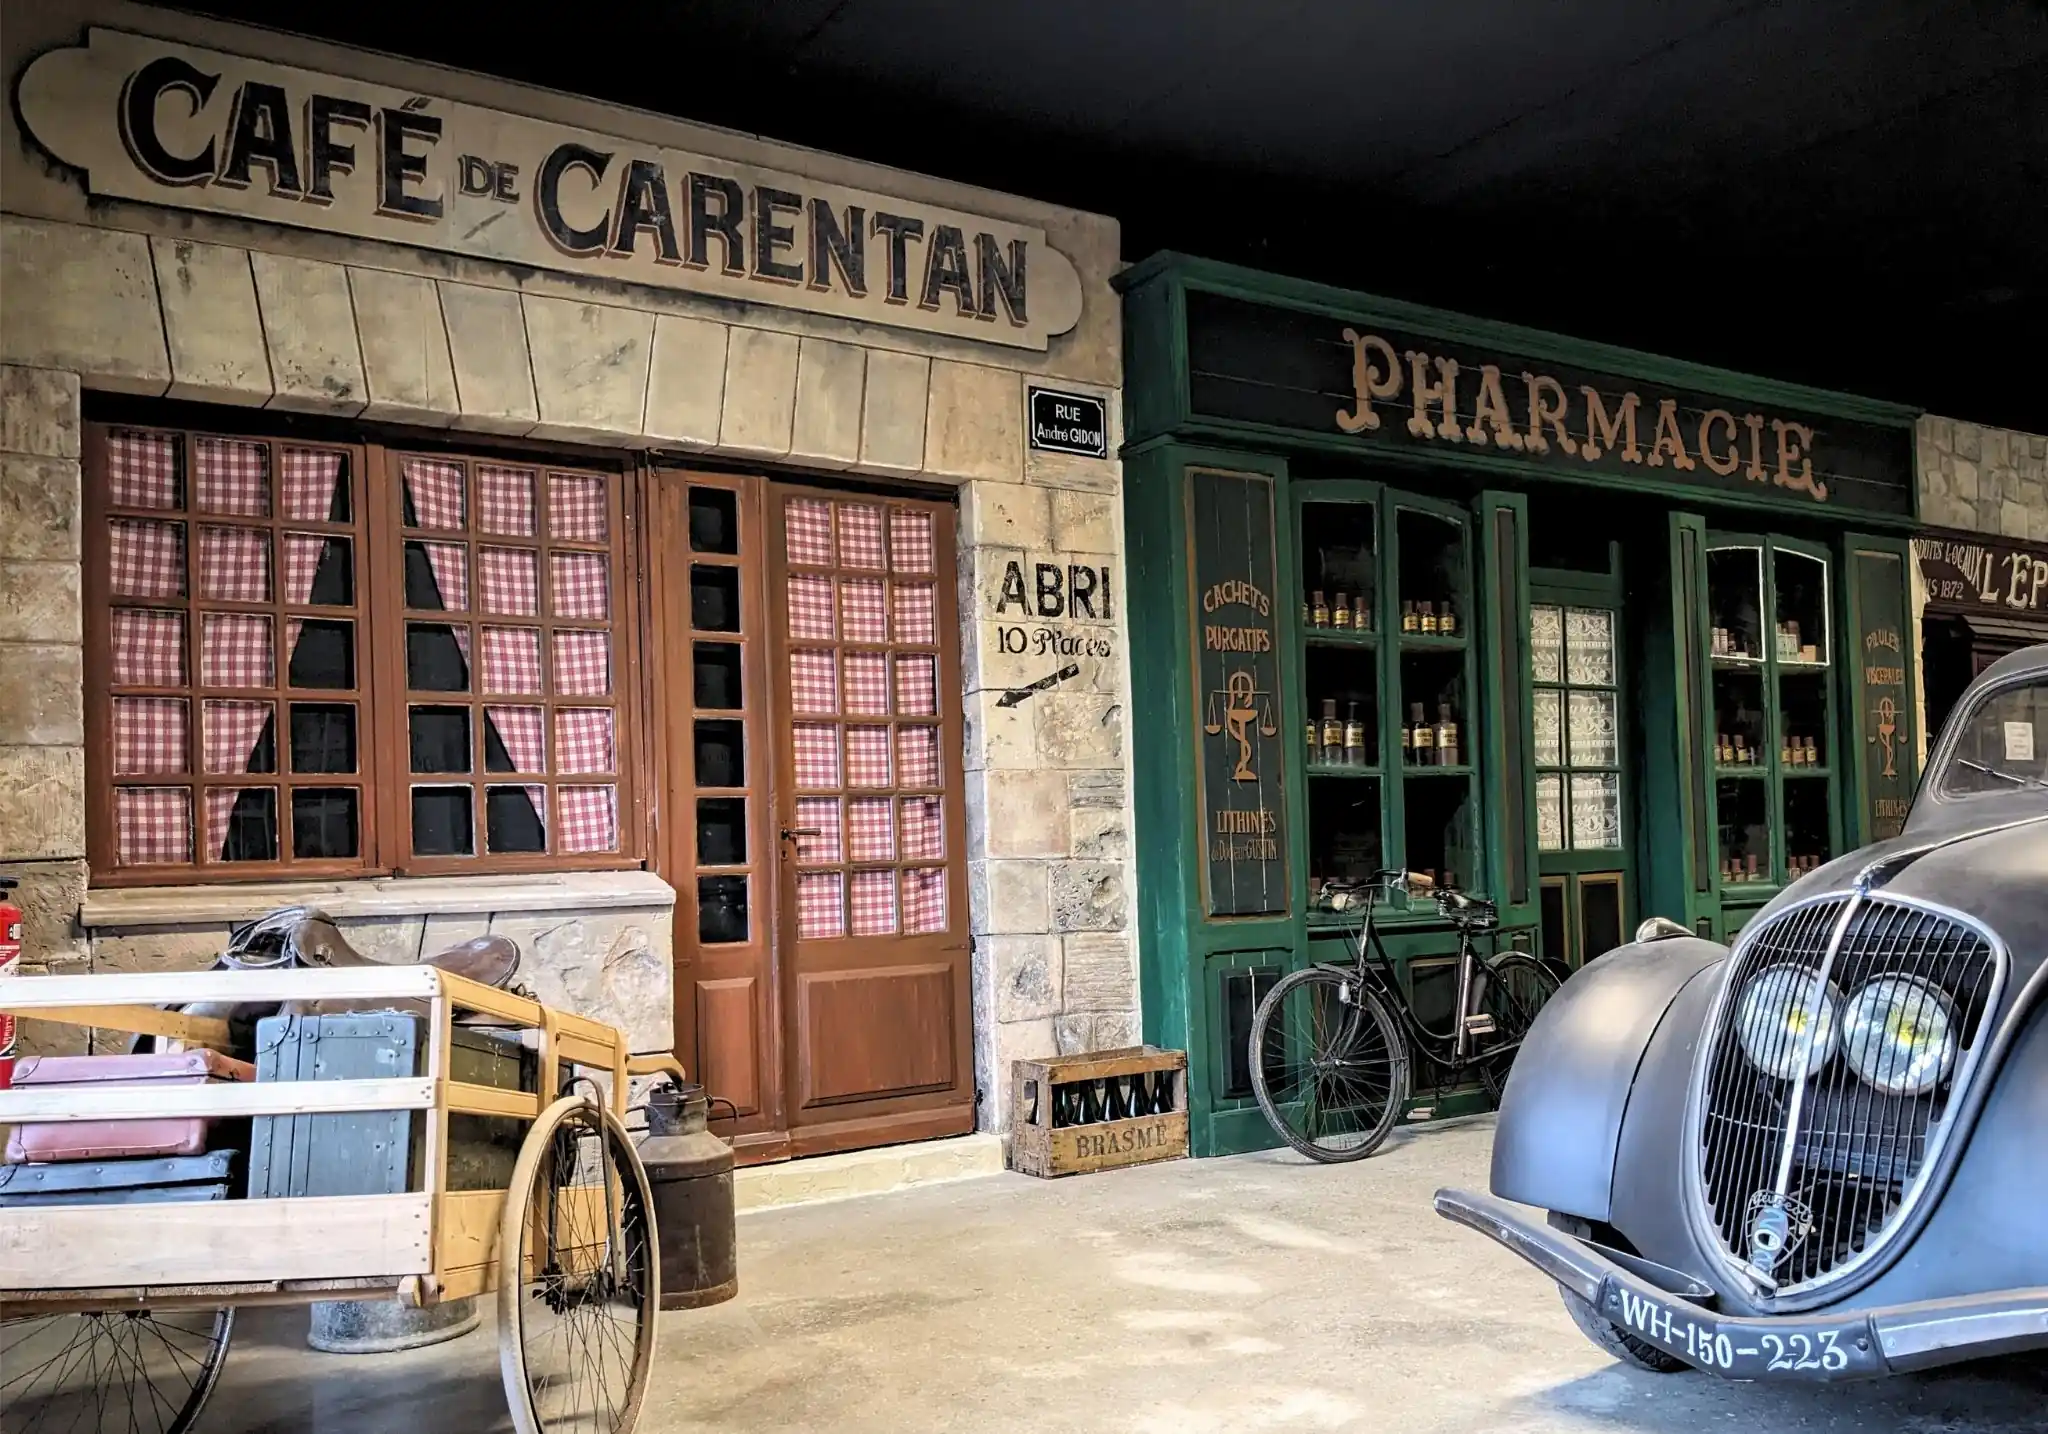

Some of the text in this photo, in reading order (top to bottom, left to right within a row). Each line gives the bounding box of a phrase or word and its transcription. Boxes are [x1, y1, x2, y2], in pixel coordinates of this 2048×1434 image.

[117, 57, 1029, 328] CAFÉ DE CARENTAN
[1056, 404, 1081, 422] RUE
[1336, 328, 1827, 501] PHARMACIE
[1037, 422, 1101, 447] André GIDON
[1912, 538, 1943, 561] ODUITS
[1945, 542, 1985, 593] LOCAUX
[996, 561, 1111, 620] ABRI
[1203, 580, 1270, 617] CACHETS
[1941, 579, 1964, 600] 1872
[997, 626, 1111, 657] 10 Places
[1205, 625, 1271, 653] PURGATIFS
[1075, 1123, 1168, 1159] BRASME
